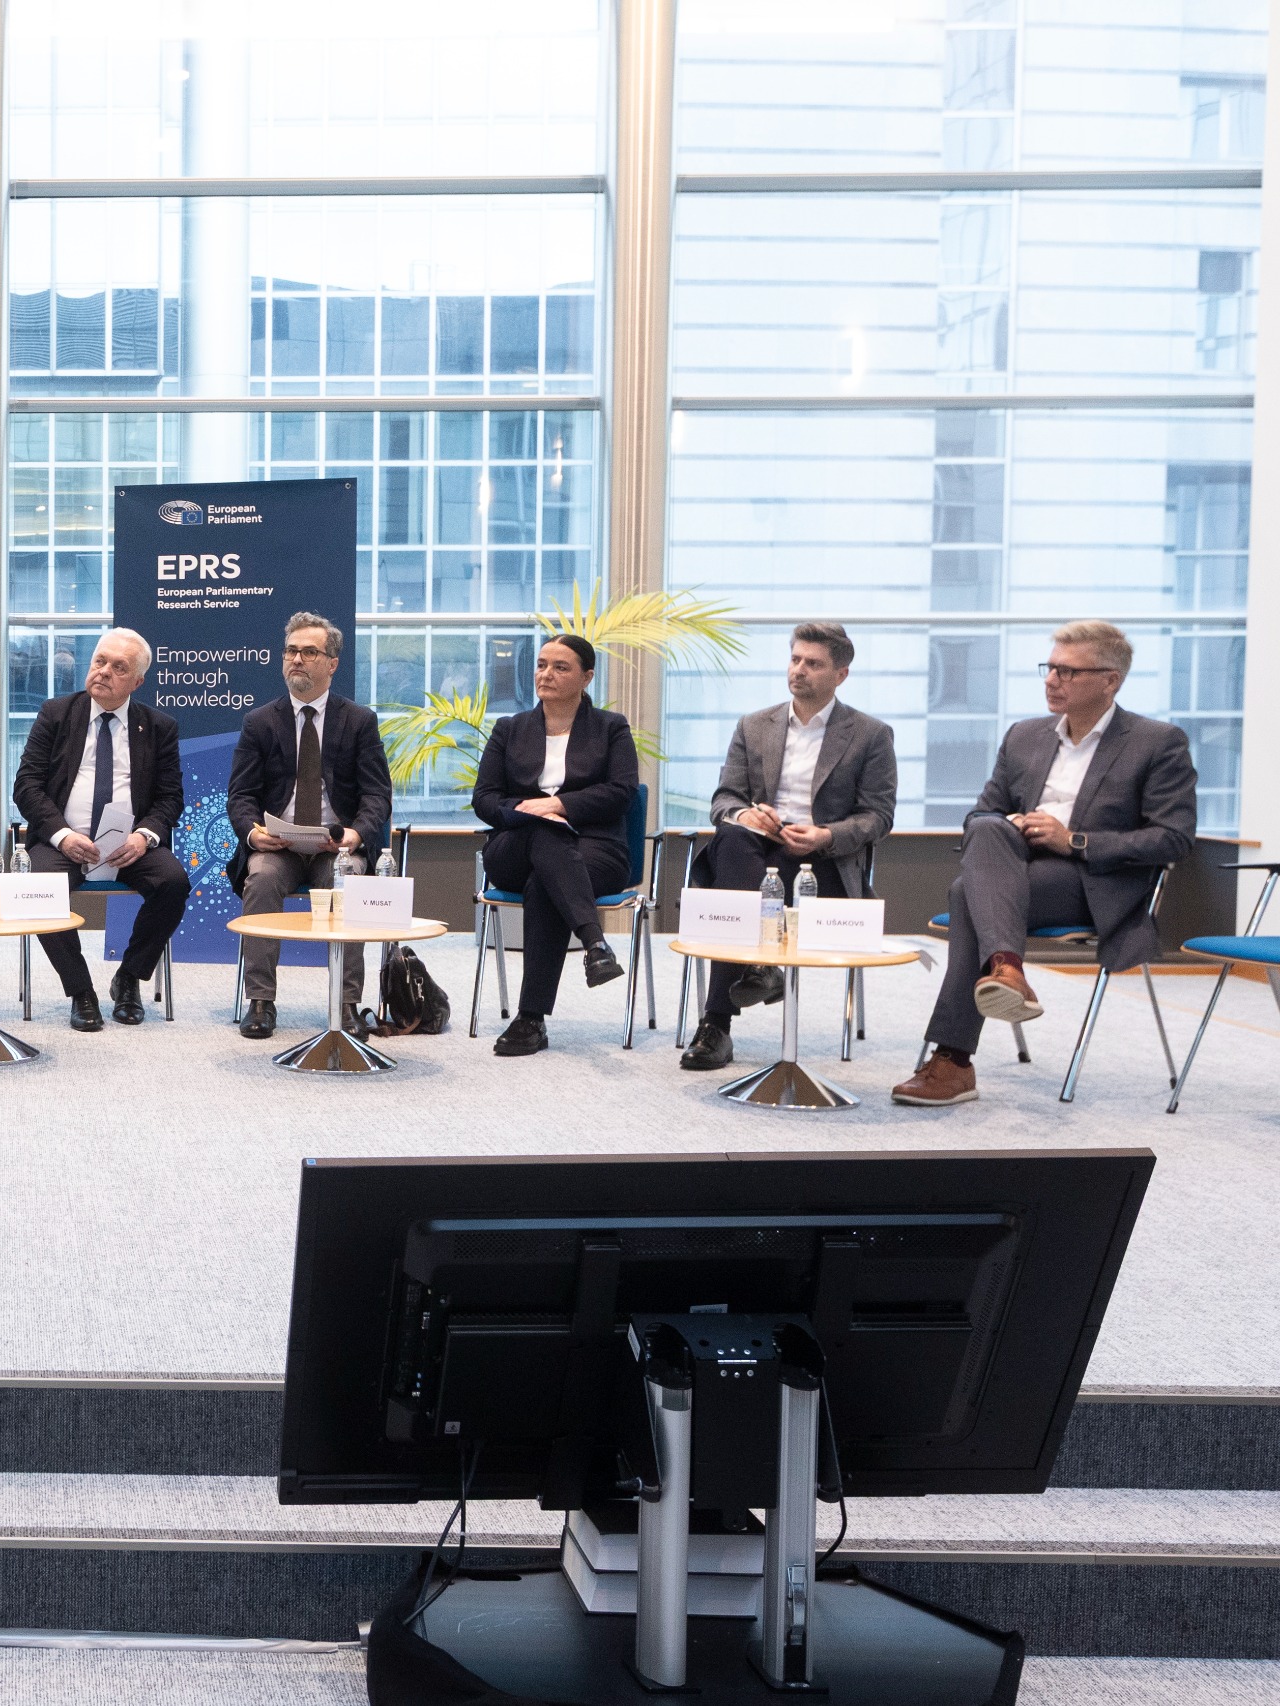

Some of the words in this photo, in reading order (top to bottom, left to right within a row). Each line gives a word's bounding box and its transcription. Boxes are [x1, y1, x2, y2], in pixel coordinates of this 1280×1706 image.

[207, 504, 256, 515] European
[207, 515, 262, 524] Parliament
[157, 554, 241, 580] EPRS
[157, 587, 203, 598] European
[206, 586, 273, 596] Parliamentary
[157, 600, 201, 609] Research
[204, 600, 239, 608] Service
[157, 647, 270, 665] Empowering
[157, 668, 228, 688] through
[156, 691, 254, 709] knowledge
